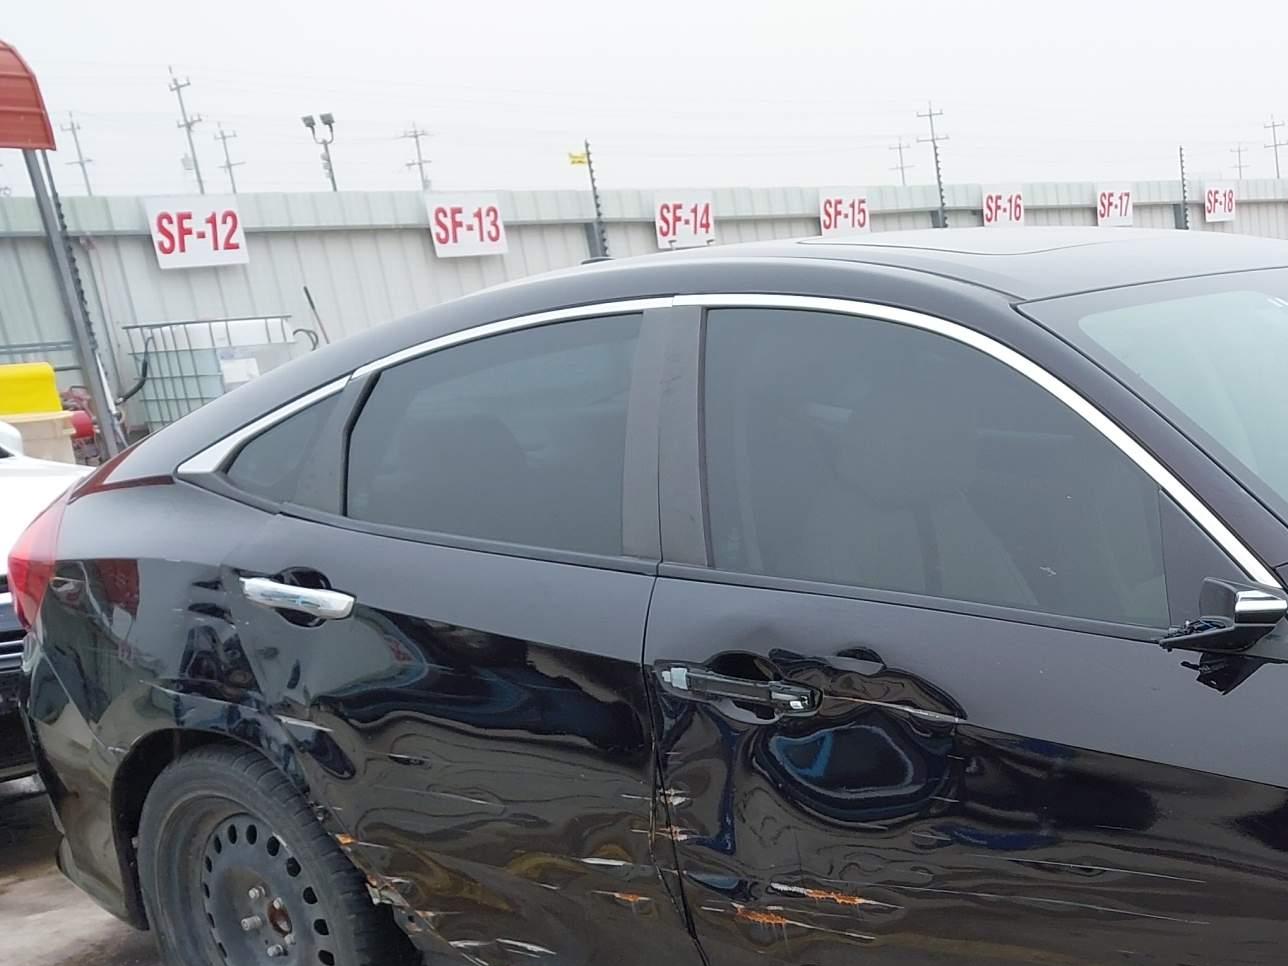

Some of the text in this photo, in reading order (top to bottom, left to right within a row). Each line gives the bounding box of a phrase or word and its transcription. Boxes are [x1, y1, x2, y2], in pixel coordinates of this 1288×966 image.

[823, 199, 867, 230] SF-15
[985, 194, 1022, 224] SF-16
[1099, 192, 1131, 218] SF-17
[1206, 189, 1233, 214] SF-18
[156, 210, 240, 255] SF-12
[434, 206, 501, 245] SF-13
[659, 203, 711, 238] SF-14
